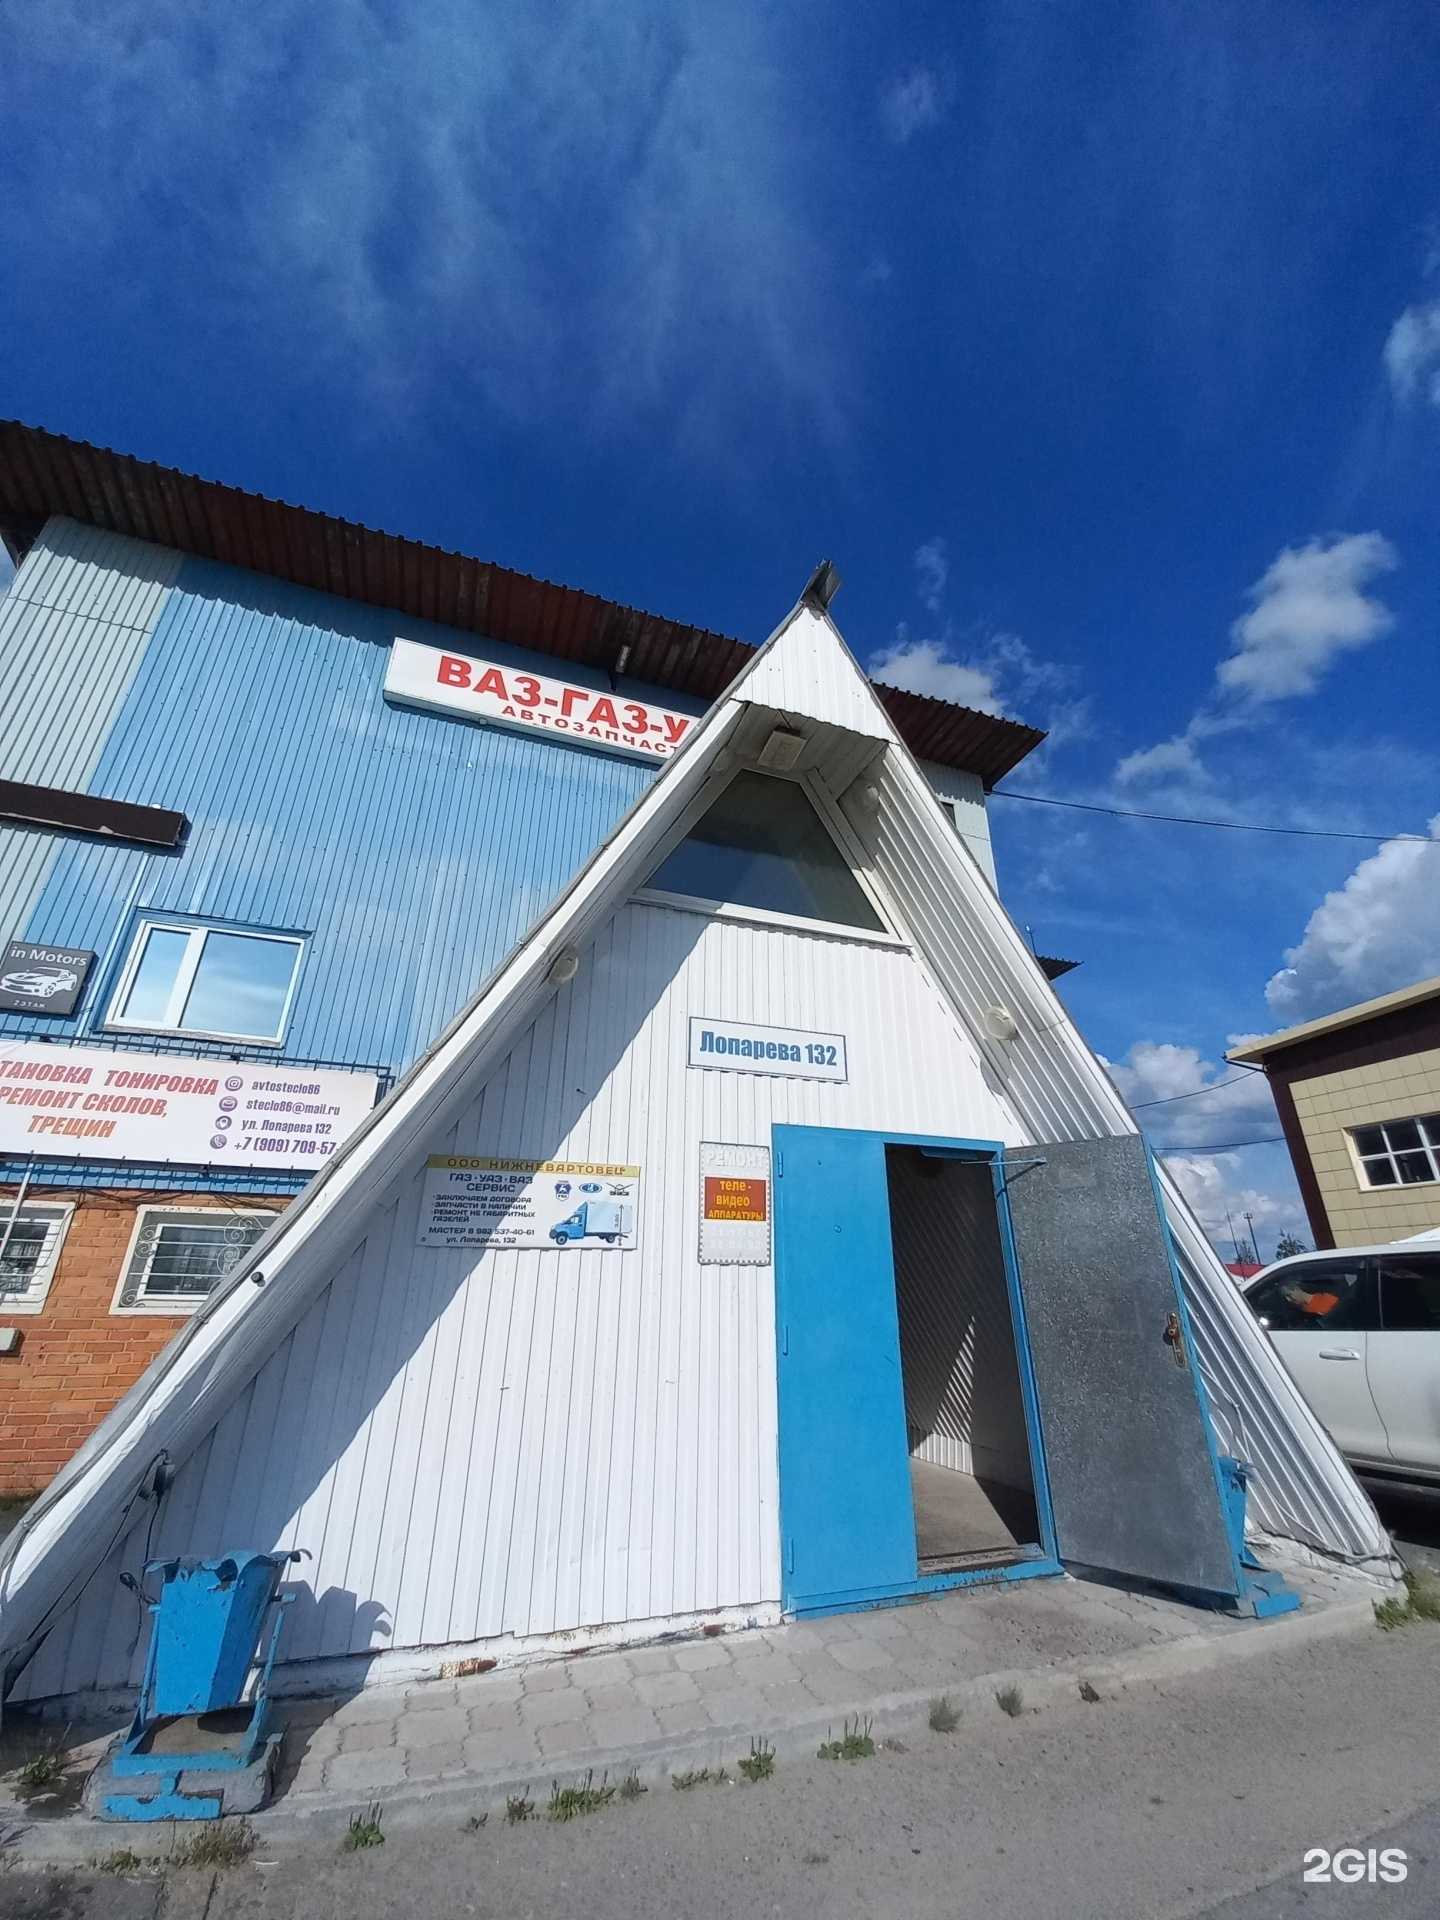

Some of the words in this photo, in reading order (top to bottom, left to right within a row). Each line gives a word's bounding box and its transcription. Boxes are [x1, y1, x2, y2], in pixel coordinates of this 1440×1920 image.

[436, 655, 690, 744] ВАЗ-ГАЗ-У
[10, 946, 26, 959] in
[29, 949, 87, 967] Motors
[700, 1030, 800, 1062] Лопарева
[805, 1043, 837, 1066] 132
[104, 1070, 219, 1096] ТОНИРОВКА
[251, 1080, 321, 1095] avtosteclo86
[0, 1086, 82, 1109] РЕМОНТ
[82, 1093, 168, 1117] СКОЛОВ,
[246, 1098, 340, 1116] steclo86@mail.ru
[27, 1115, 117, 1139] ТРЕЩИН
[240, 1119, 258, 1131] ул.
[260, 1120, 312, 1134] Лопарева
[314, 1123, 332, 1135] 132
[234, 1137, 252, 1151] +7
[253, 1138, 289, 1153] (909)
[447, 1158, 480, 1168] ООО
[449, 1173, 472, 1182] ГАЗ
[479, 1174, 503, 1183] УАЗ
[509, 1176, 533, 1184] ВАЗ
[466, 1183, 516, 1193] СЕРВИС
[708, 1209, 763, 1221] АППАРАТУРЫ
